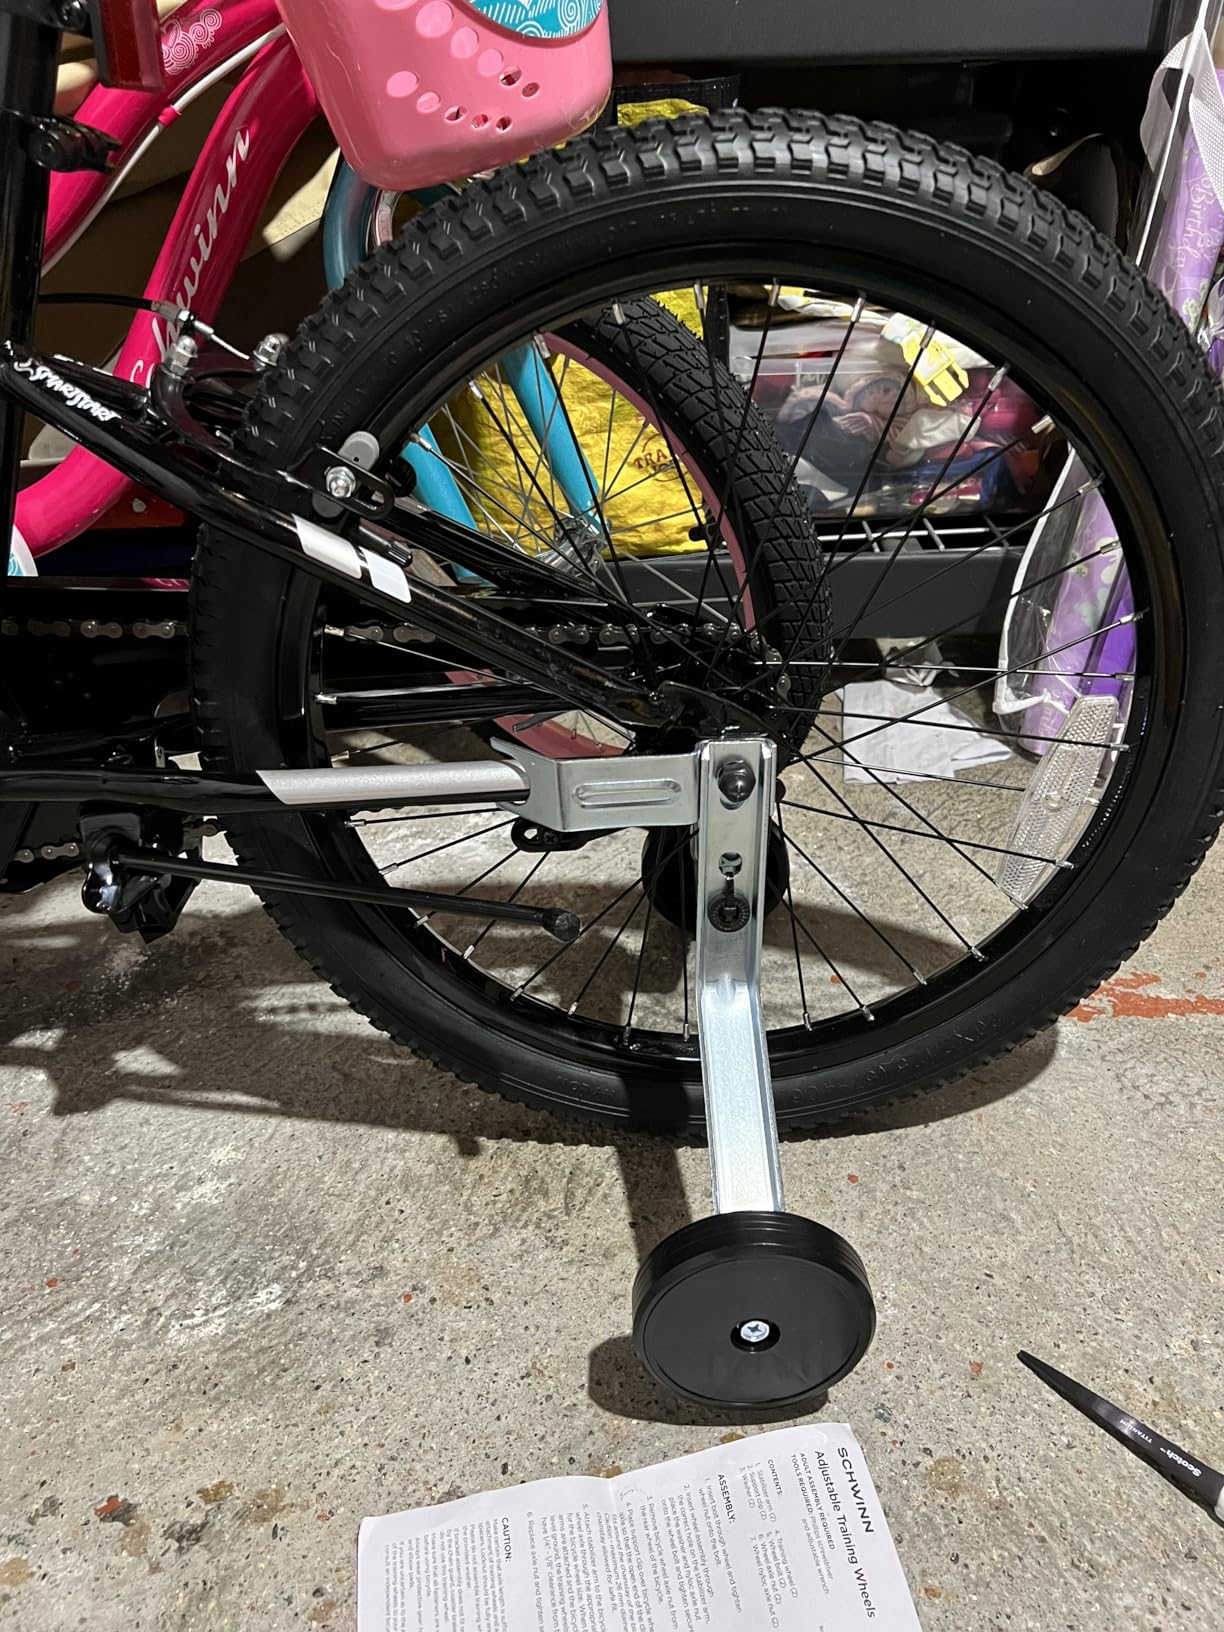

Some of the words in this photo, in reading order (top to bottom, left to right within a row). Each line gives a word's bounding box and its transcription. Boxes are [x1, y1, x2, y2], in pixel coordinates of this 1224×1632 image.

[130, 129, 250, 389] hwinn
[633, 448, 668, 469] TRA
[1165, 1449, 1202, 1477] Scotch
[767, 1458, 783, 1497] CONTENTS:
[790, 1453, 803, 1478] TOOLS
[797, 1476, 814, 1516] REQUIRED:
[676, 1493, 685, 1507] the
[697, 1487, 710, 1509] wheel
[706, 1484, 717, 1506] Insert
[716, 1474, 737, 1525] ASSEMBLY:
[748, 1471, 762, 1499] Support
[755, 1497, 765, 1511] clip
[837, 1446, 875, 1533] SCHWINN
[639, 1504, 647, 1518] the
[660, 1498, 670, 1516] onto
[667, 1496, 678, 1516] place
[685, 1491, 695, 1513] Insert
[710, 1503, 720, 1520] bolt
[764, 1498, 774, 1513] arm
[799, 1452, 812, 1475] ADULT
[806, 1475, 824, 1511] ASSEMBLY
[818, 1511, 836, 1551] REQUIRED
[641, 1517, 651, 1532] rear
[647, 1502, 659, 1532] Remove
[663, 1515, 672, 1529] the
[672, 1515, 681, 1529] the
[679, 1506, 691, 1533] correct
[689, 1511, 701, 1534] wheel
[702, 1507, 712, 1522] nut
[501, 1516, 513, 1563] CAUTION:
[667, 1528, 678, 1550] wheel
[685, 1531, 695, 1549] hole
[705, 1520, 715, 1539] onto
[713, 1518, 727, 1548] through
[814, 1450, 842, 1512] Adjustable
[836, 1514, 859, 1565] Training
[853, 1567, 877, 1619] Wheels
[644, 1531, 656, 1555] wheel
[653, 1530, 665, 1558] bicycle
[675, 1528, 687, 1554] washer
[694, 1533, 709, 1567] assembly
[709, 1537, 718, 1551] the
[767, 1538, 781, 1563] Wheel
[671, 1549, 681, 1566] bolt
[681, 1554, 691, 1570] and
[721, 1547, 733, 1571] wheel
[751, 1543, 764, 1568] Wheel
[759, 1540, 773, 1565] Wheel
[776, 1536, 789, 1566] Training
[783, 1564, 797, 1587] wheel
[650, 1562, 659, 1576] the
[658, 1556, 671, 1580] wheel
[674, 1565, 685, 1581] and
[691, 1558, 700, 1573] the
[765, 1564, 776, 1580] axle
[773, 1561, 784, 1578] bolt
[663, 1579, 672, 1596] axle
[702, 1566, 715, 1598] through
[726, 1570, 737, 1587] and
[770, 1579, 779, 1594] nut
[653, 1575, 665, 1605] bicycle.
[677, 1580, 689, 1609] tighten
[688, 1590, 699, 1607] axle
[730, 1585, 743, 1614] tighten
[763, 1587, 773, 1603] axle
[666, 1595, 676, 1610] nut
[767, 1602, 777, 1617] nut
[669, 1609, 679, 1631] from
[693, 1607, 702, 1622] nut
